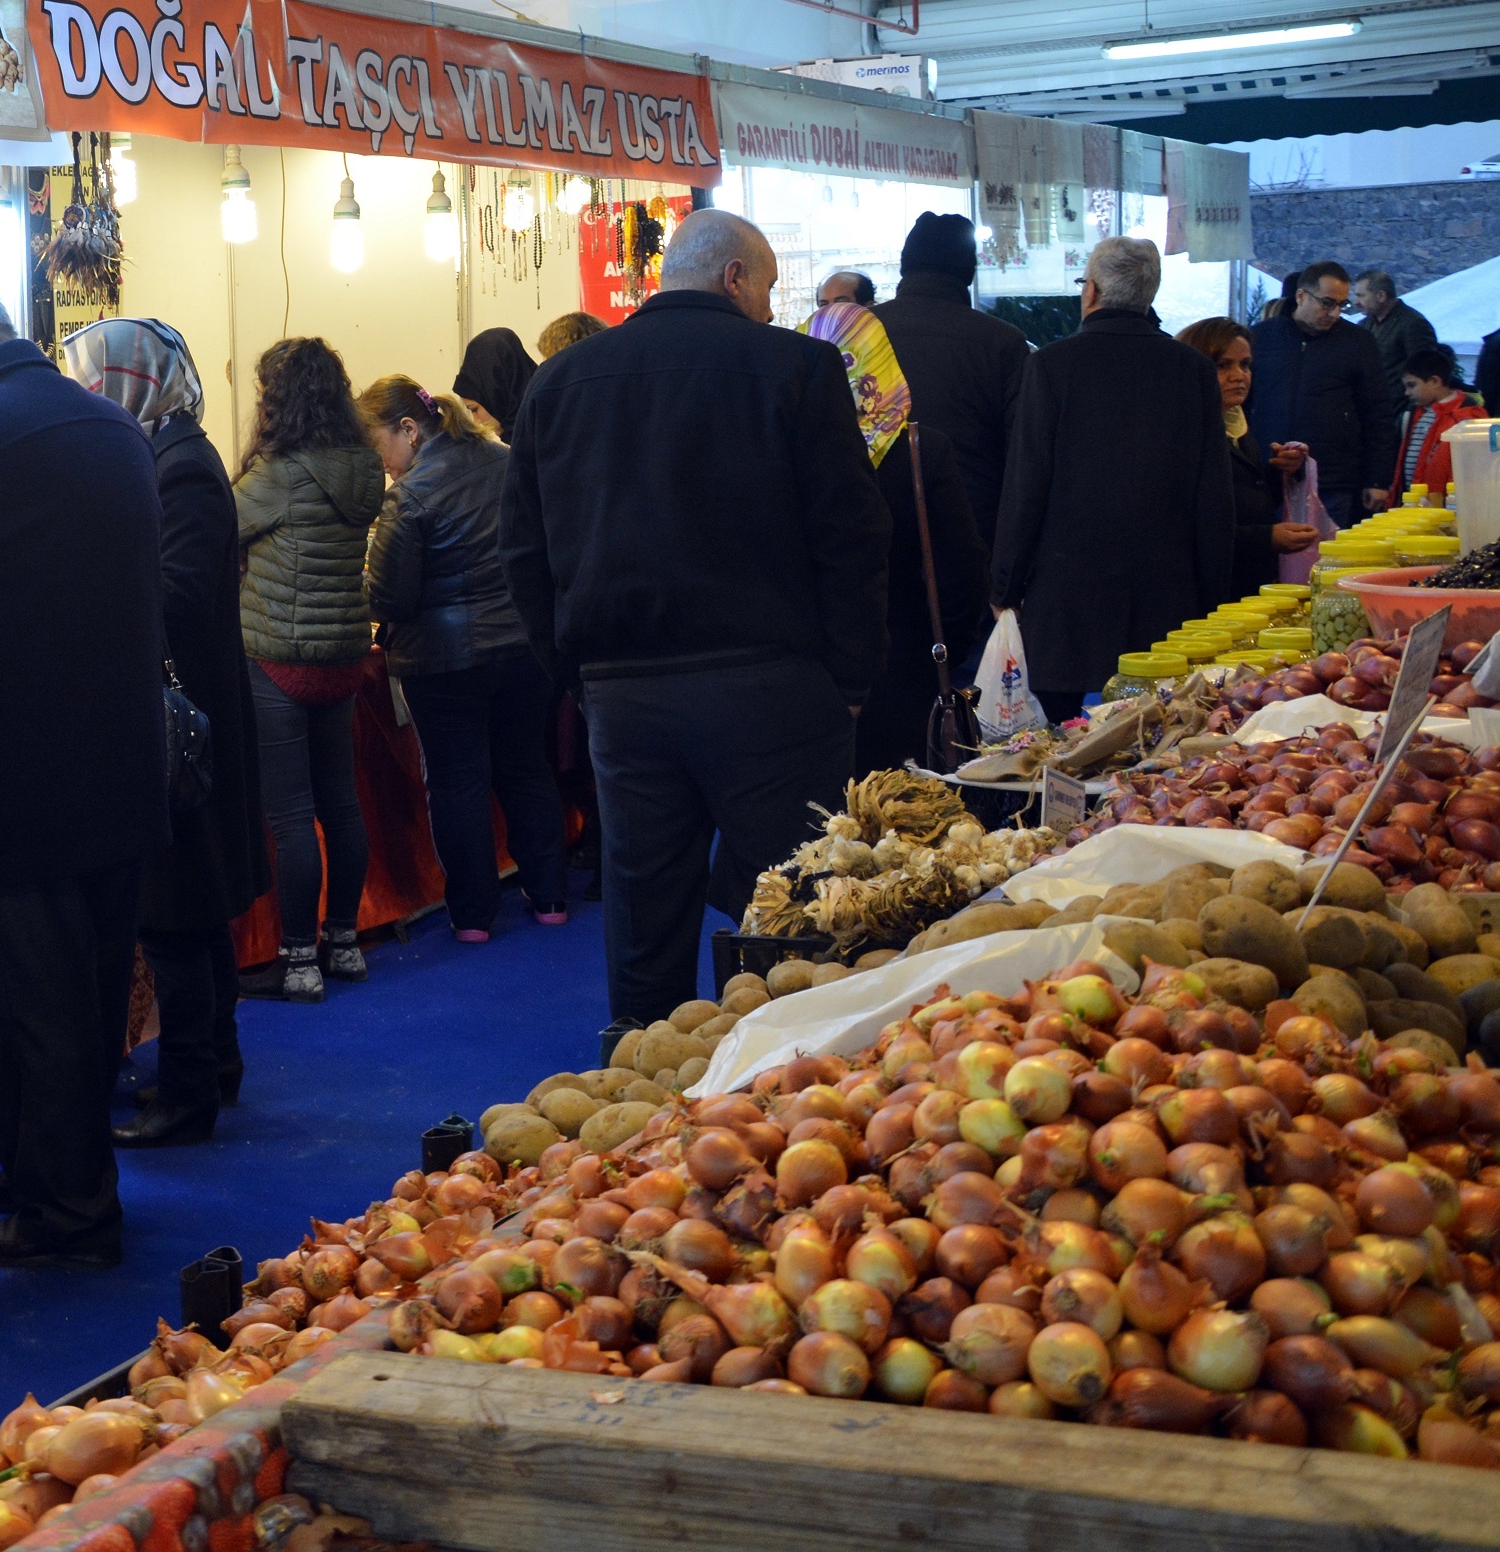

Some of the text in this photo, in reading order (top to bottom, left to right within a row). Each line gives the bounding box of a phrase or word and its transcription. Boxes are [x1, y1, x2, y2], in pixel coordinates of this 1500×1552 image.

[42, 0, 718, 167] DOĞAL TAŞÇI YILMAZ USTA
[866, 65, 910, 76] merinos
[810, 120, 860, 170] DUBAİ
[52, 166, 82, 177] EKLE
